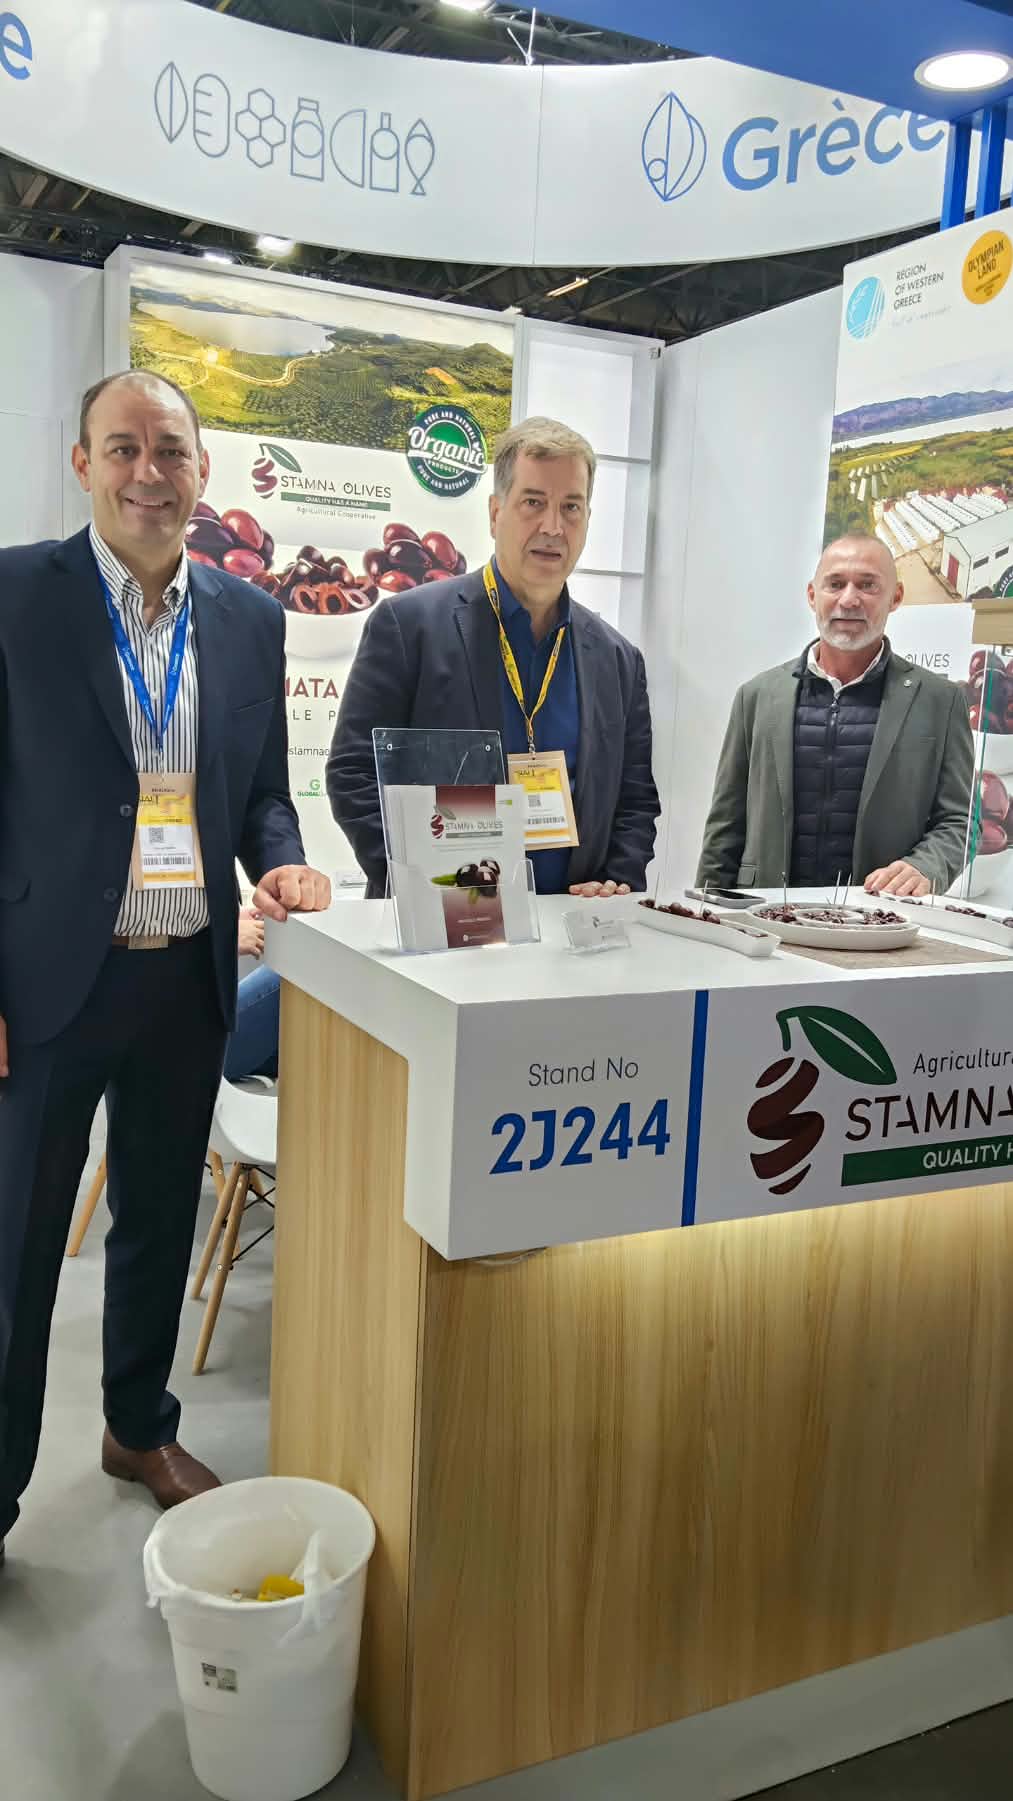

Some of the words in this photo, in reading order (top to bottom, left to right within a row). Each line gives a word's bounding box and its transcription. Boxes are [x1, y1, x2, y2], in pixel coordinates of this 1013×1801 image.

[896, 263, 926, 281] REGION
[977, 258, 997, 280] LAND
[895, 284, 905, 296] OF
[907, 272, 944, 290] WESTERN
[893, 293, 922, 310] GREECE
[408, 426, 485, 467] Organic
[281, 475, 336, 492] STAMNA
[343, 482, 392, 499] OLIVES
[528, 1059, 595, 1087] Stand
[606, 1056, 639, 1080] No
[913, 1048, 1013, 1078] Agricultur
[489, 1098, 671, 1175] 2J244
[922, 1143, 1002, 1169] QUALITY
